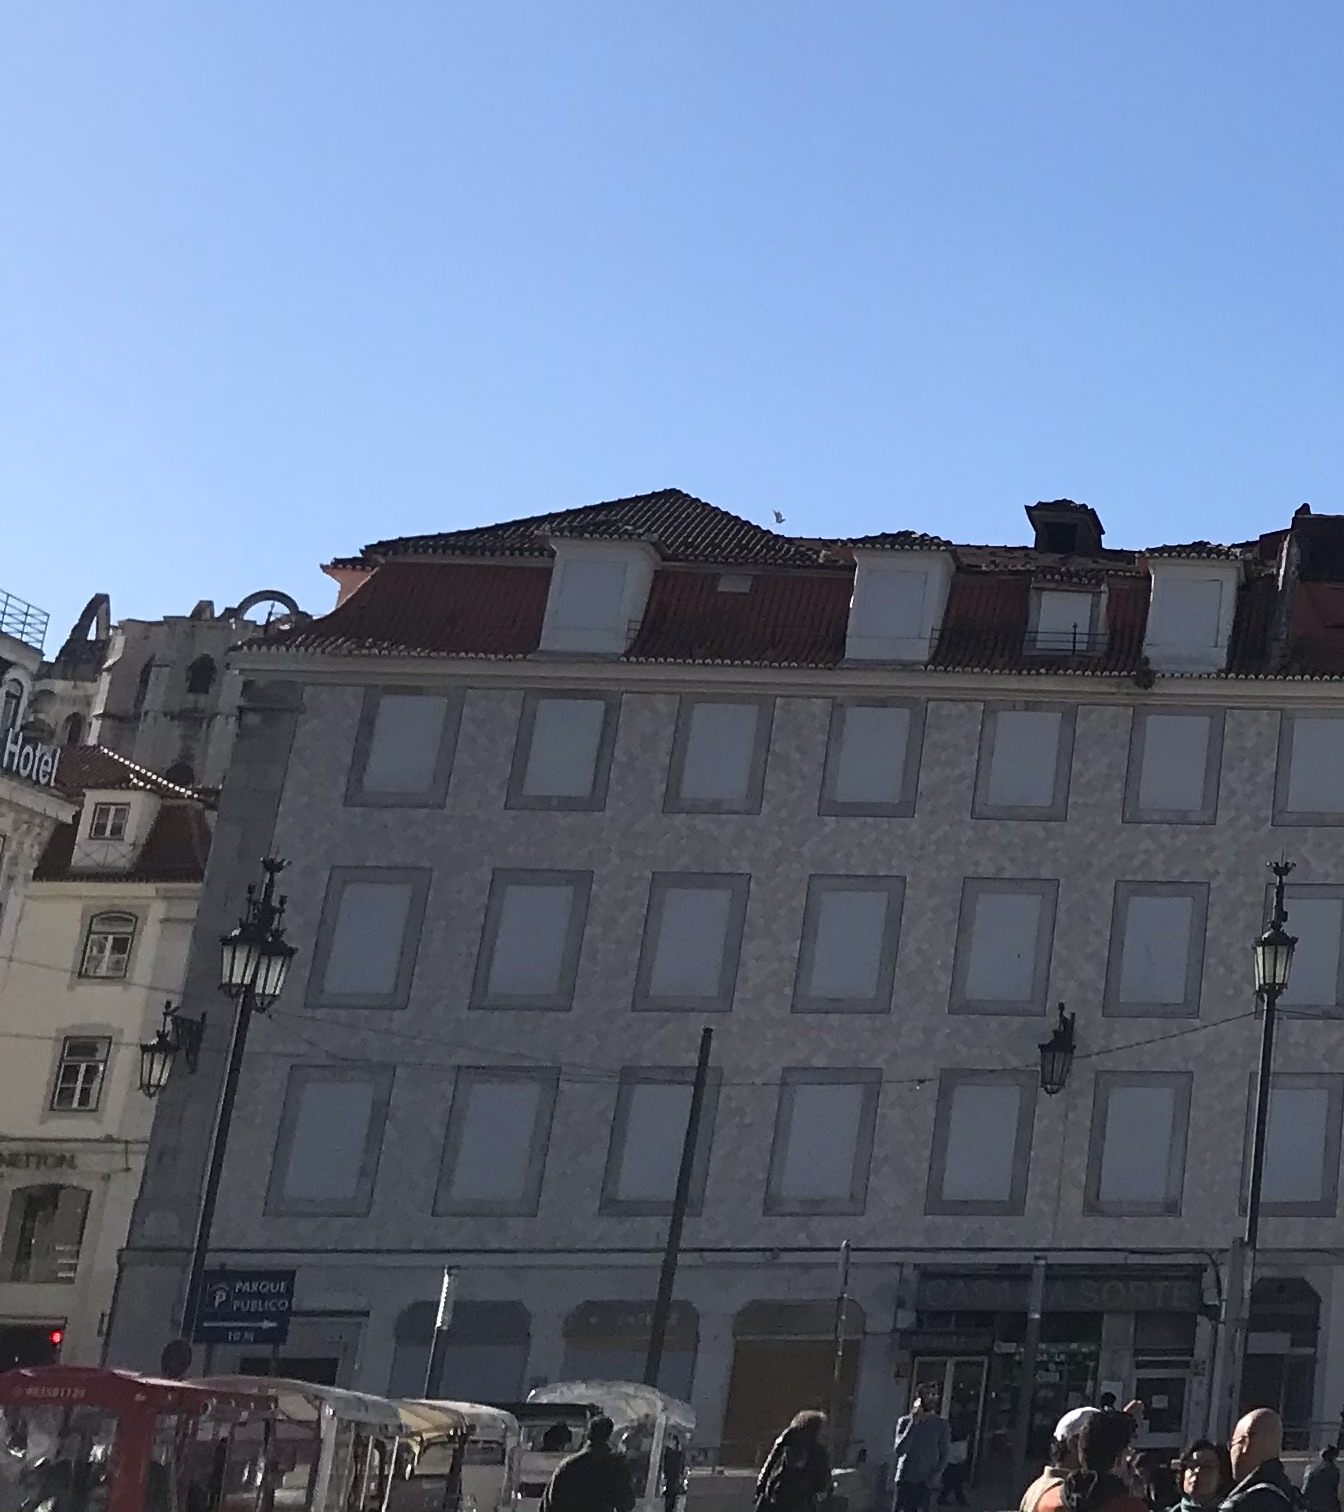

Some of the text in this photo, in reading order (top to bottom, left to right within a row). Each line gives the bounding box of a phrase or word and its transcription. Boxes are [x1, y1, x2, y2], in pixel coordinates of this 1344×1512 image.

[3, 727, 61, 787] Hotel
[235, 1279, 288, 1294] PARQUE
[1078, 1279, 1192, 1308] SORTE
